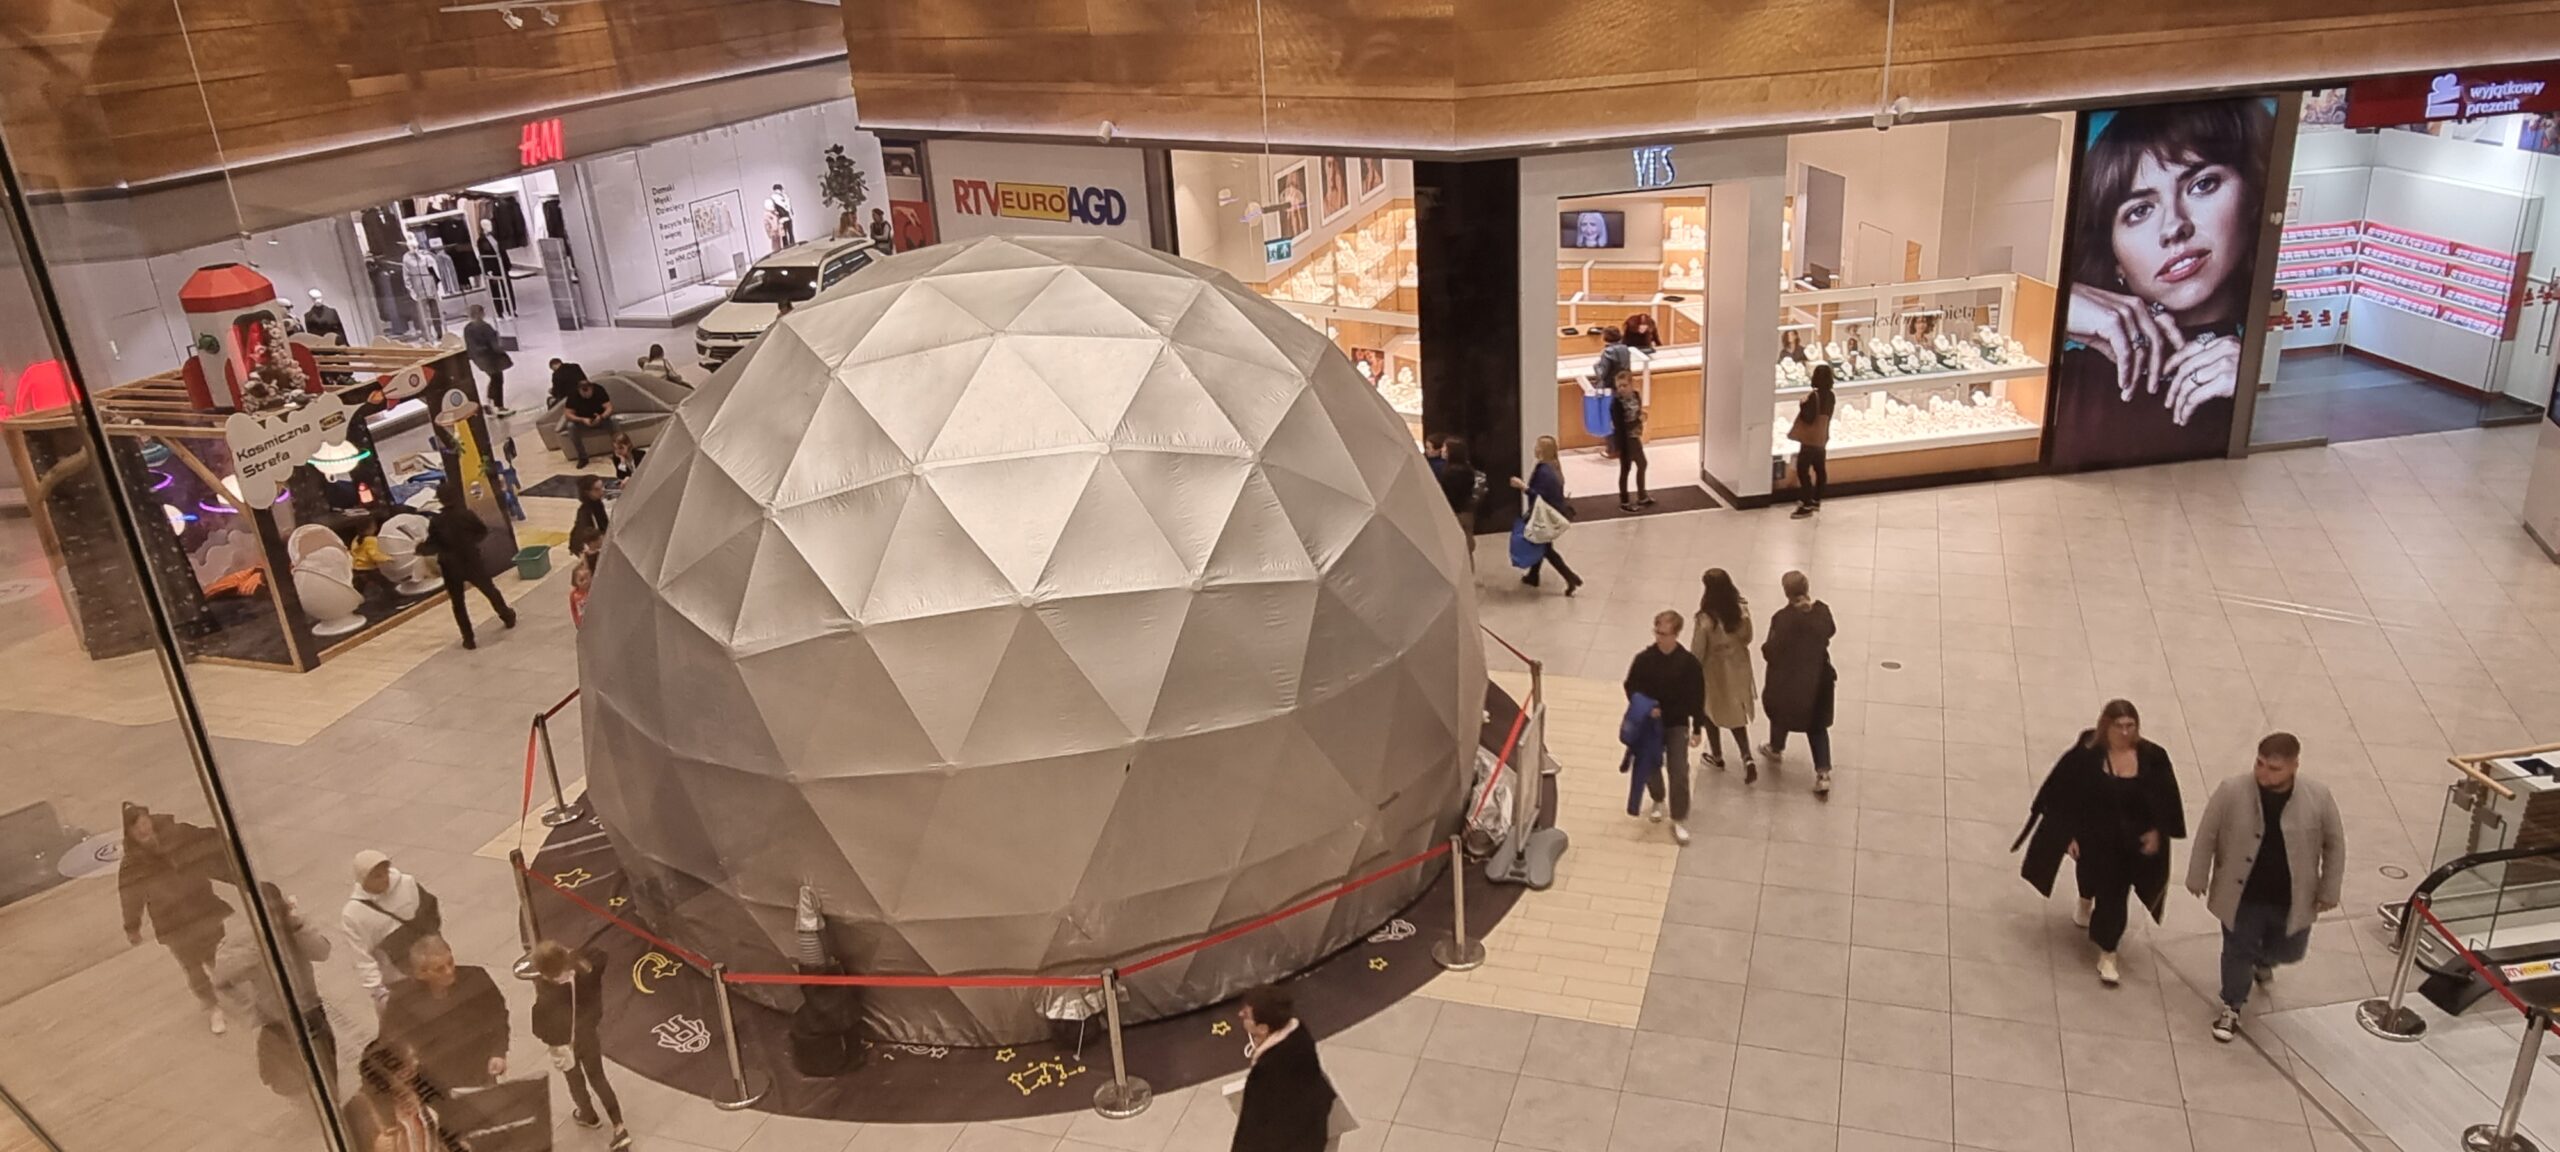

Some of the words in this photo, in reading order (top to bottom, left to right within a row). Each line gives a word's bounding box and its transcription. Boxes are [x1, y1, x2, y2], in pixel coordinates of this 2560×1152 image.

[2470, 81, 2545, 99] wyjątkowy
[2465, 98, 2520, 117] prezent
[1632, 146, 1675, 187] YES
[953, 179, 1000, 217] RTV
[1001, 190, 1066, 213] EURO
[1067, 186, 1127, 226] AGD
[236, 423, 311, 462] Kosmiczna
[243, 451, 290, 479] Strefa
